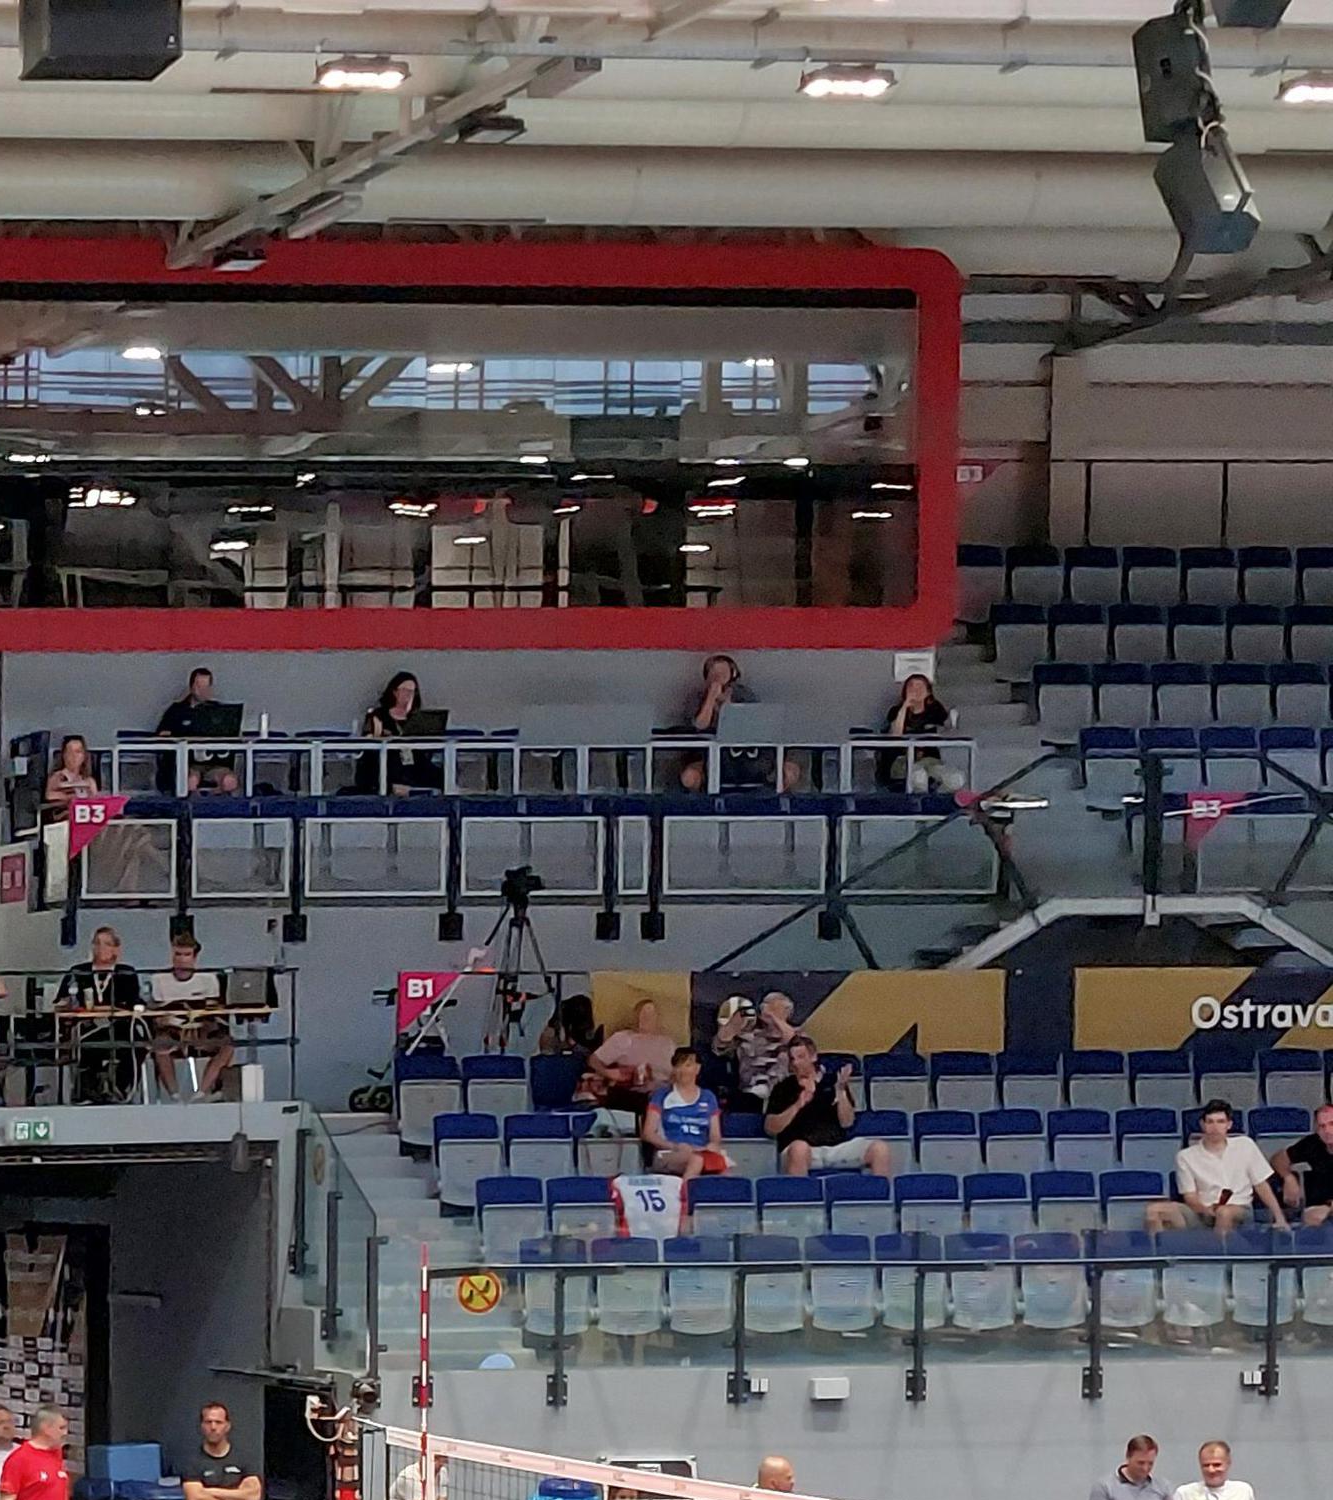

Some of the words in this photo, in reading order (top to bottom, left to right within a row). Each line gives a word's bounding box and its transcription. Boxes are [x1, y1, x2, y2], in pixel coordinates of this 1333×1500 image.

[74, 805, 106, 823] B3
[407, 980, 433, 998] B1
[1191, 996, 1333, 1030] Ostrava
[635, 1188, 666, 1213] 15
